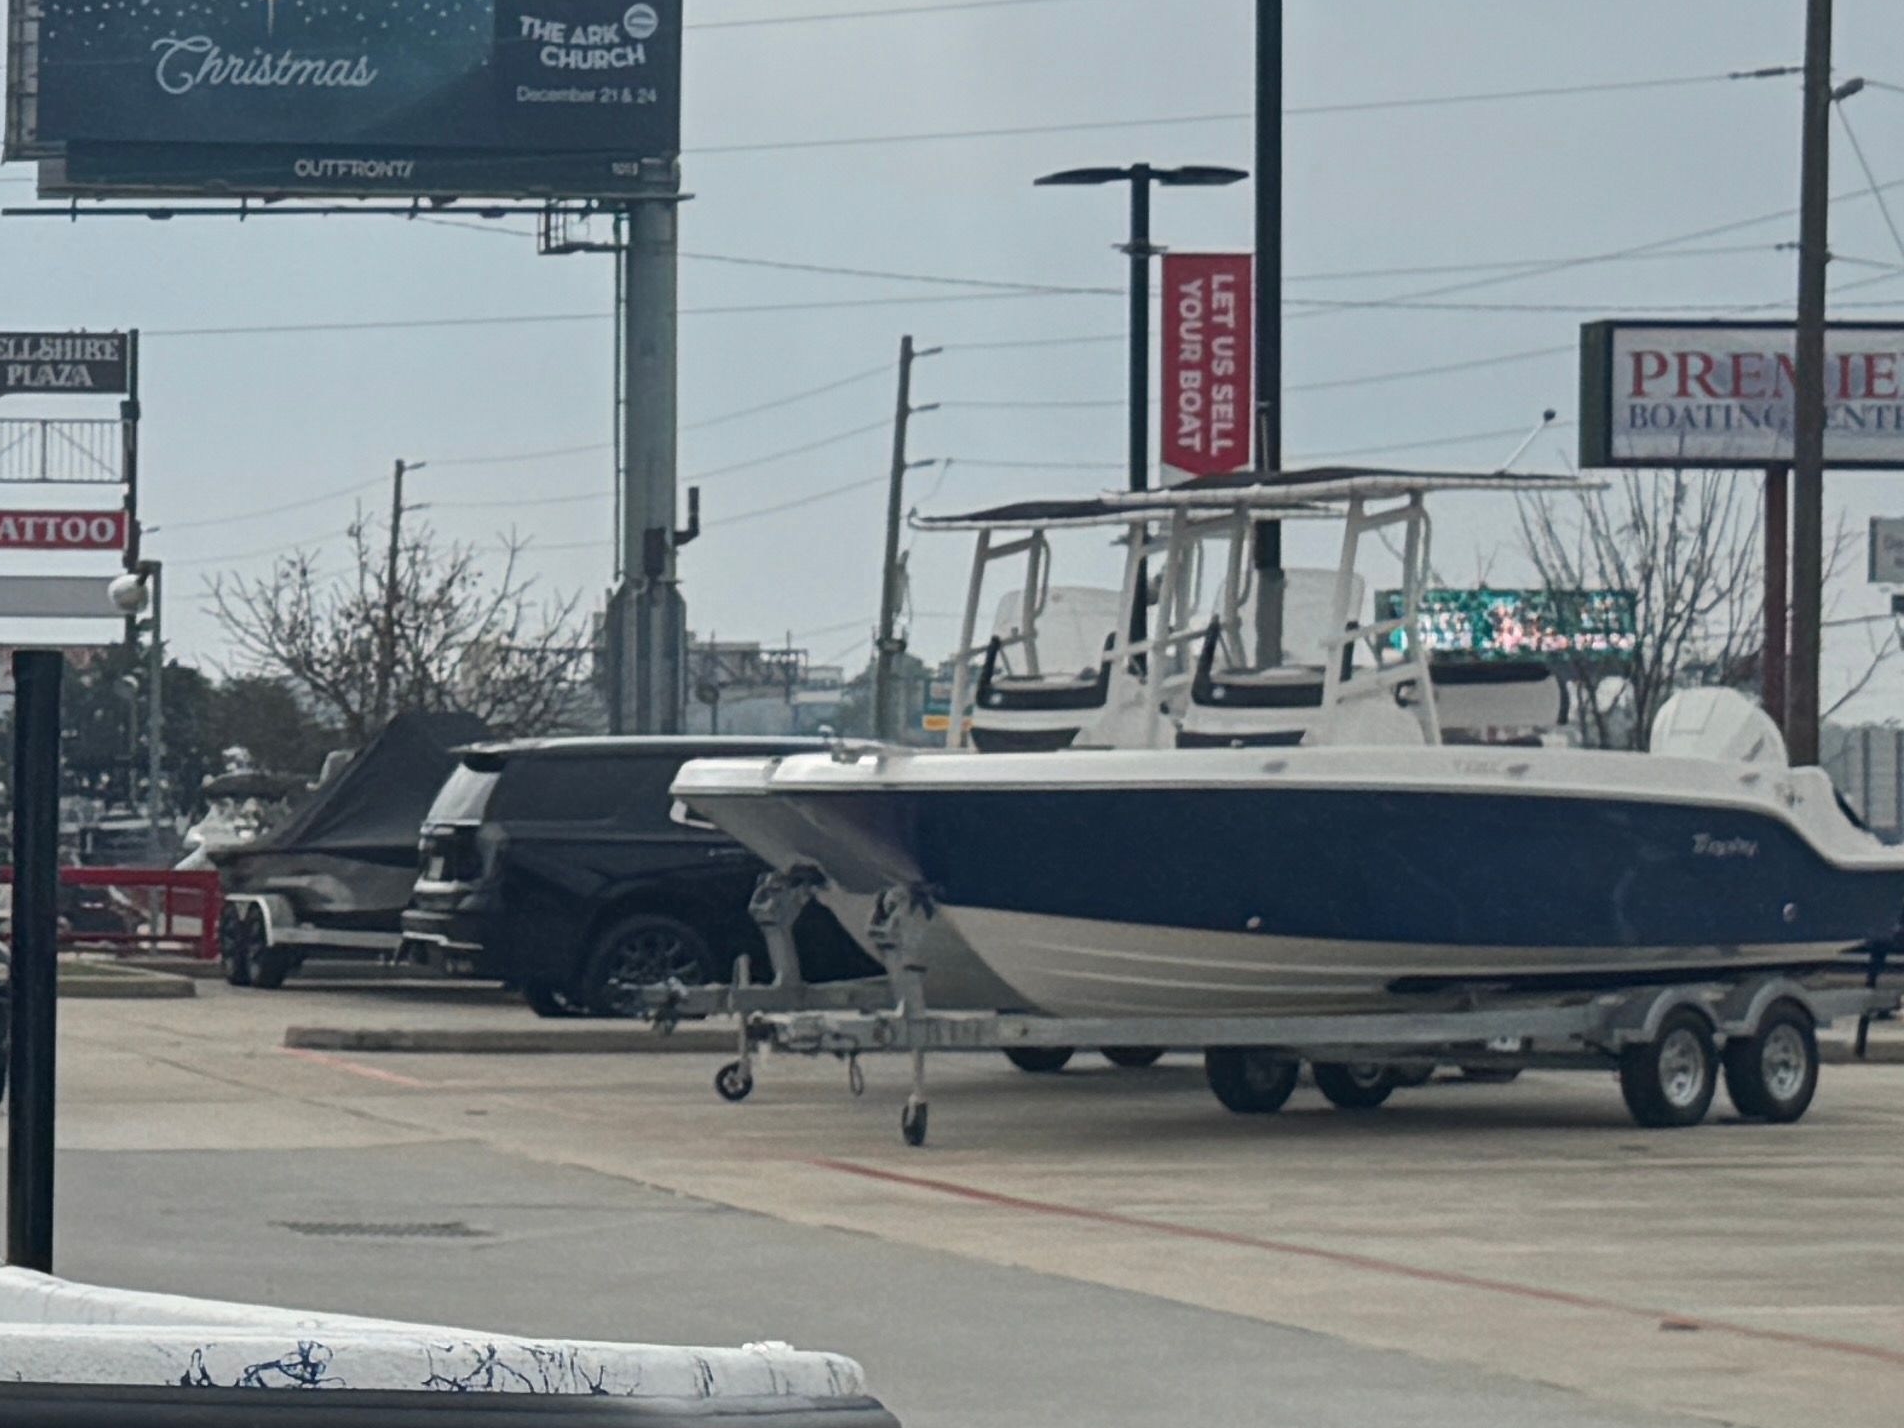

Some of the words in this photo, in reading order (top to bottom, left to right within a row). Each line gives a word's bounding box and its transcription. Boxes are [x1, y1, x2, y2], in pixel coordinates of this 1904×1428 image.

[520, 15, 566, 43] THE
[570, 23, 621, 45] ARK
[540, 43, 645, 69] CHURCH
[150, 35, 379, 94] Christmas
[1179, 278, 1204, 362] YOUR
[1211, 274, 1235, 328] LET
[5, 364, 94, 387] PLAZA
[1211, 337, 1235, 376] US
[1178, 370, 1203, 453] BOAT
[1210, 384, 1234, 457] SELL
